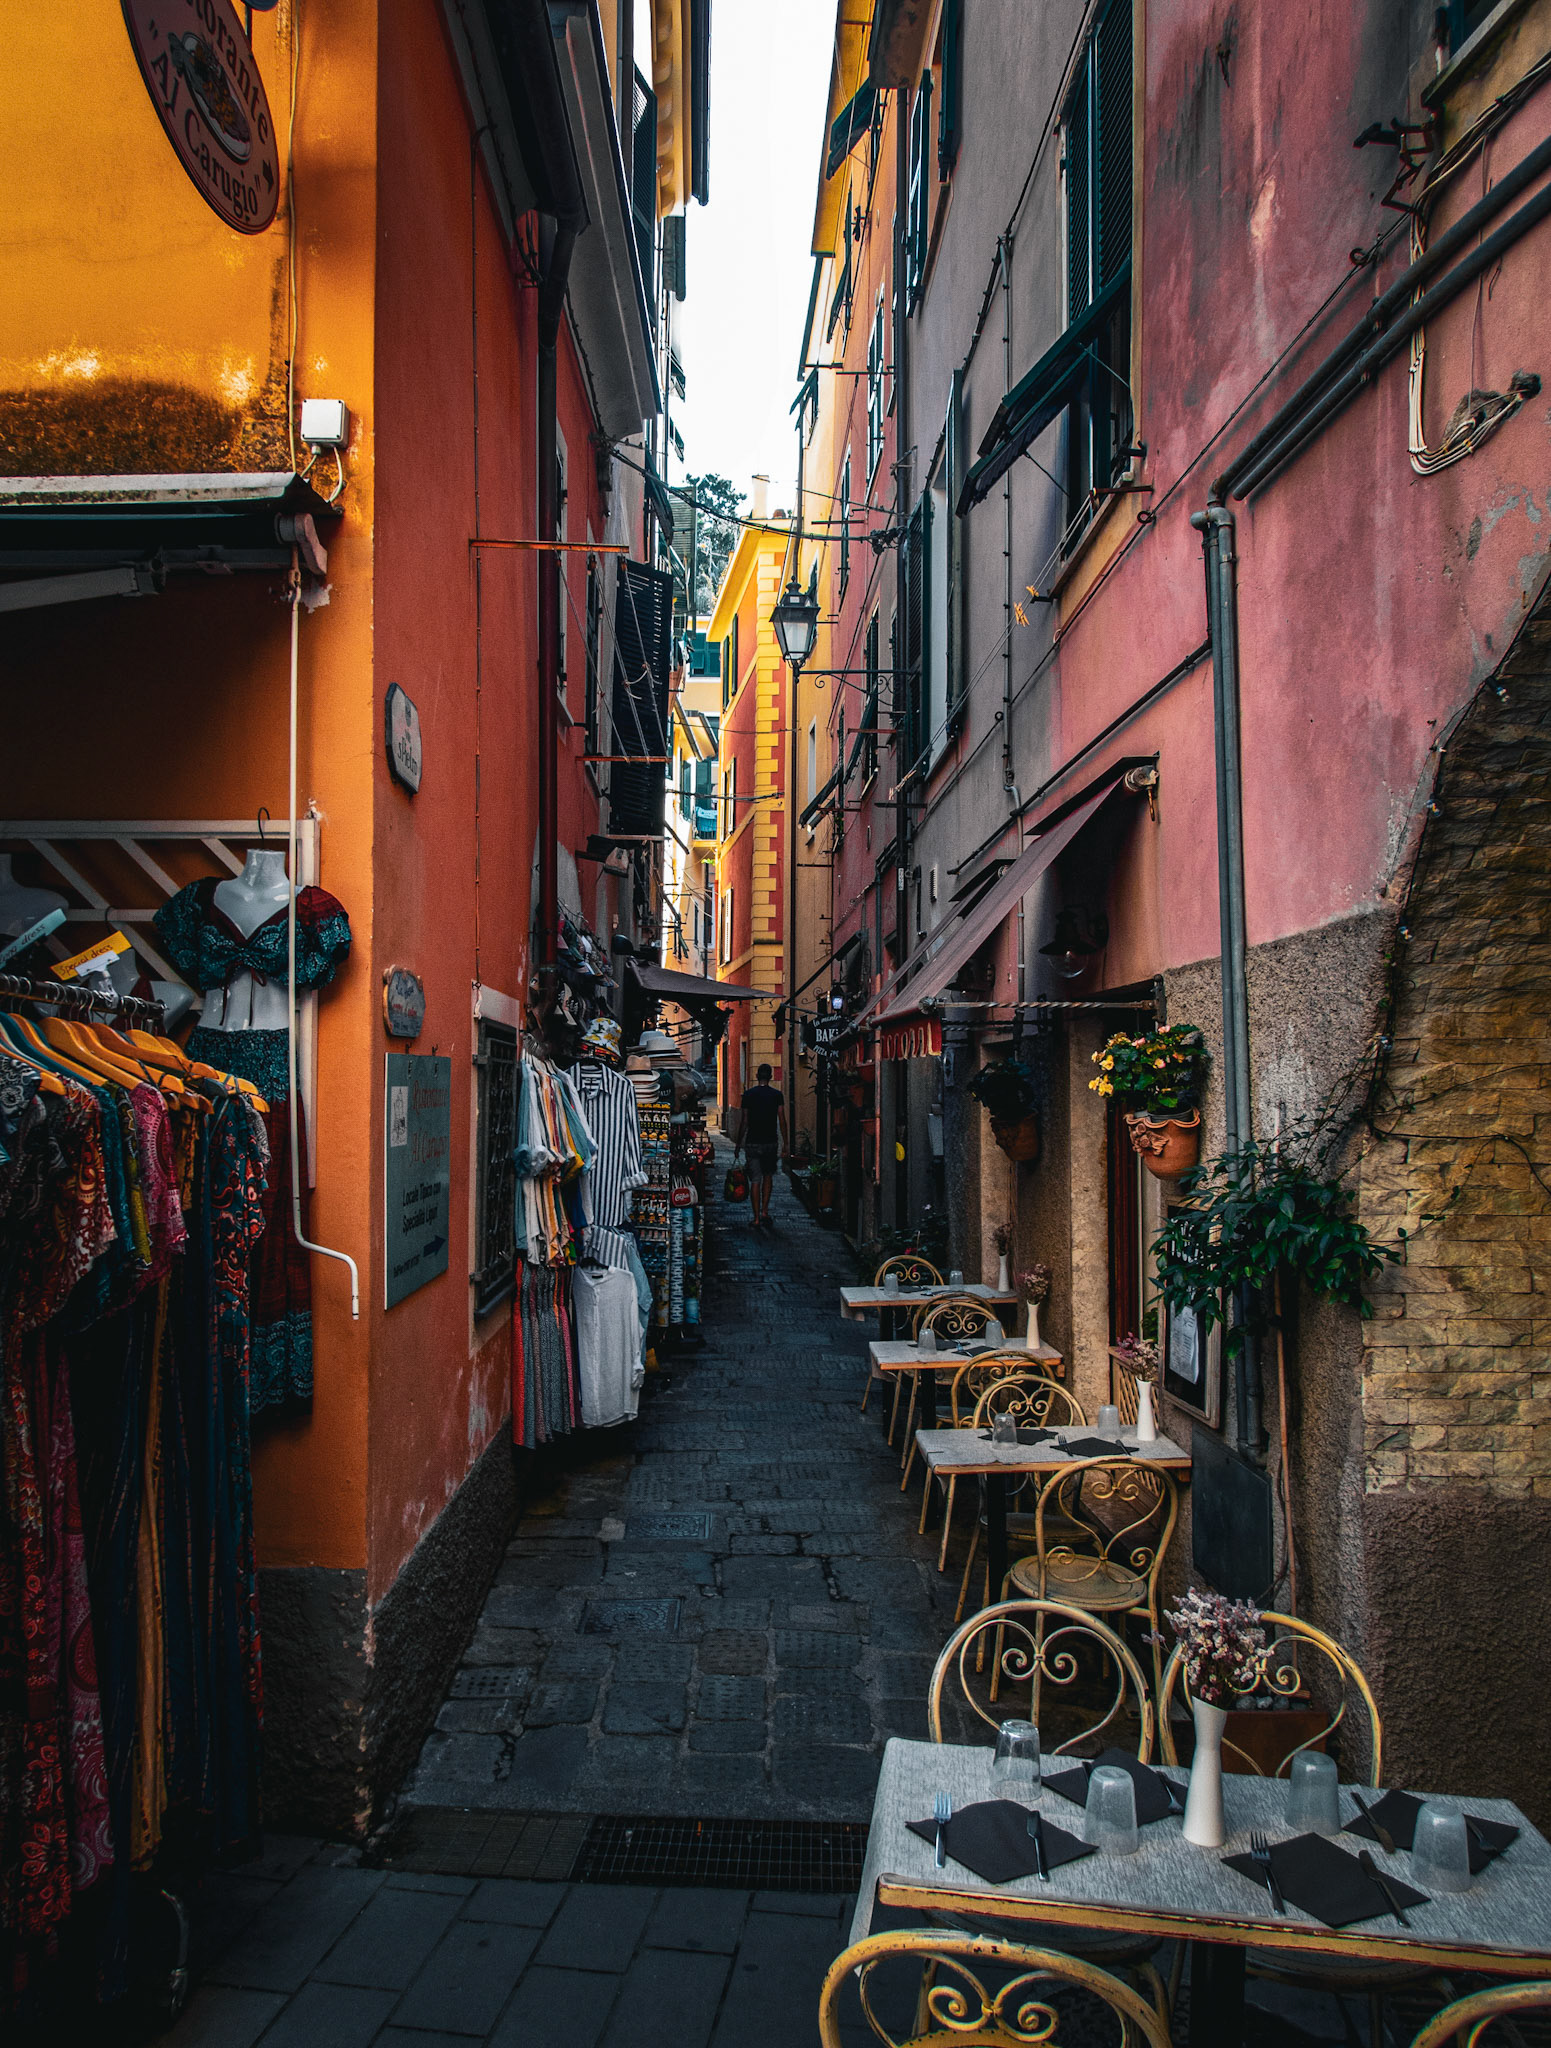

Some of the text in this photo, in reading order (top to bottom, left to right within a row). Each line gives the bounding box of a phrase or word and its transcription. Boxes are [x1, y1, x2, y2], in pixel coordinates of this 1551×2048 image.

[187, 0, 268, 145] torante
[21, 923, 46, 945] dress
[91, 944, 114, 960] dress
